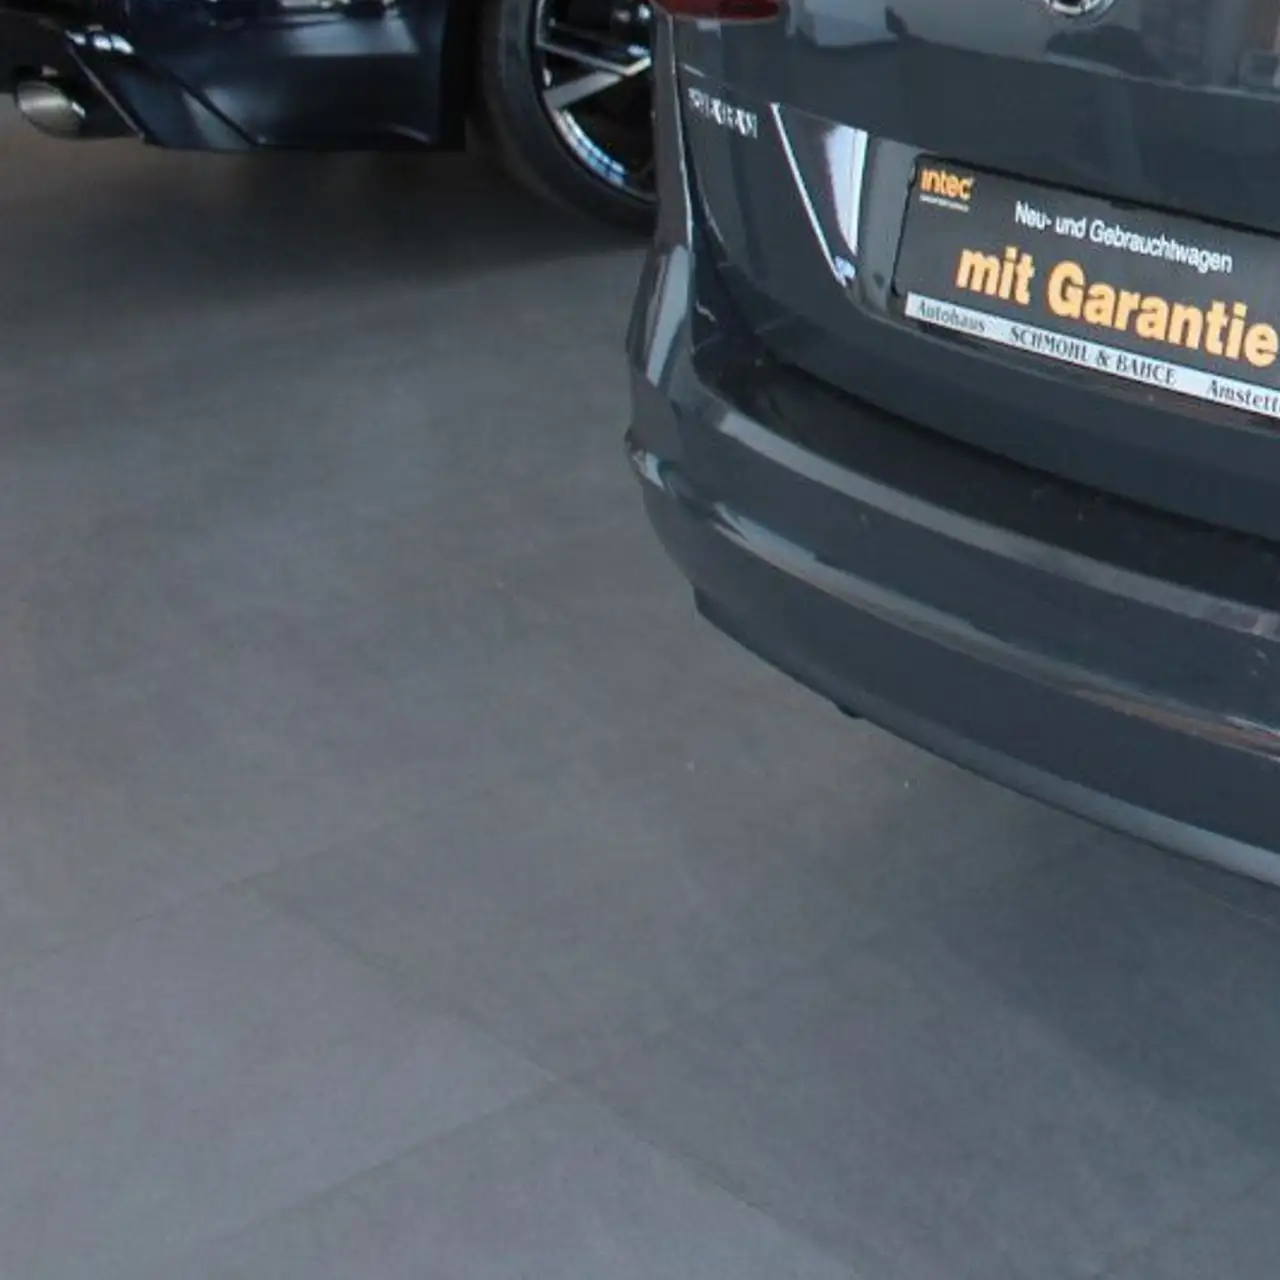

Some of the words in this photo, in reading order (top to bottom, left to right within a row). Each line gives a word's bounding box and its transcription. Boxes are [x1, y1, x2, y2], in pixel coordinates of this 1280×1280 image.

[921, 169, 973, 200] intec
[1015, 200, 1051, 231] Neu-
[1055, 217, 1087, 239] und
[1089, 219, 1233, 274] Gebrauchtwagen
[918, 299, 986, 333] Autohaus
[1095, 350, 1110, 368] &
[955, 245, 1035, 306] mit
[1047, 259, 1280, 368] Garantie
